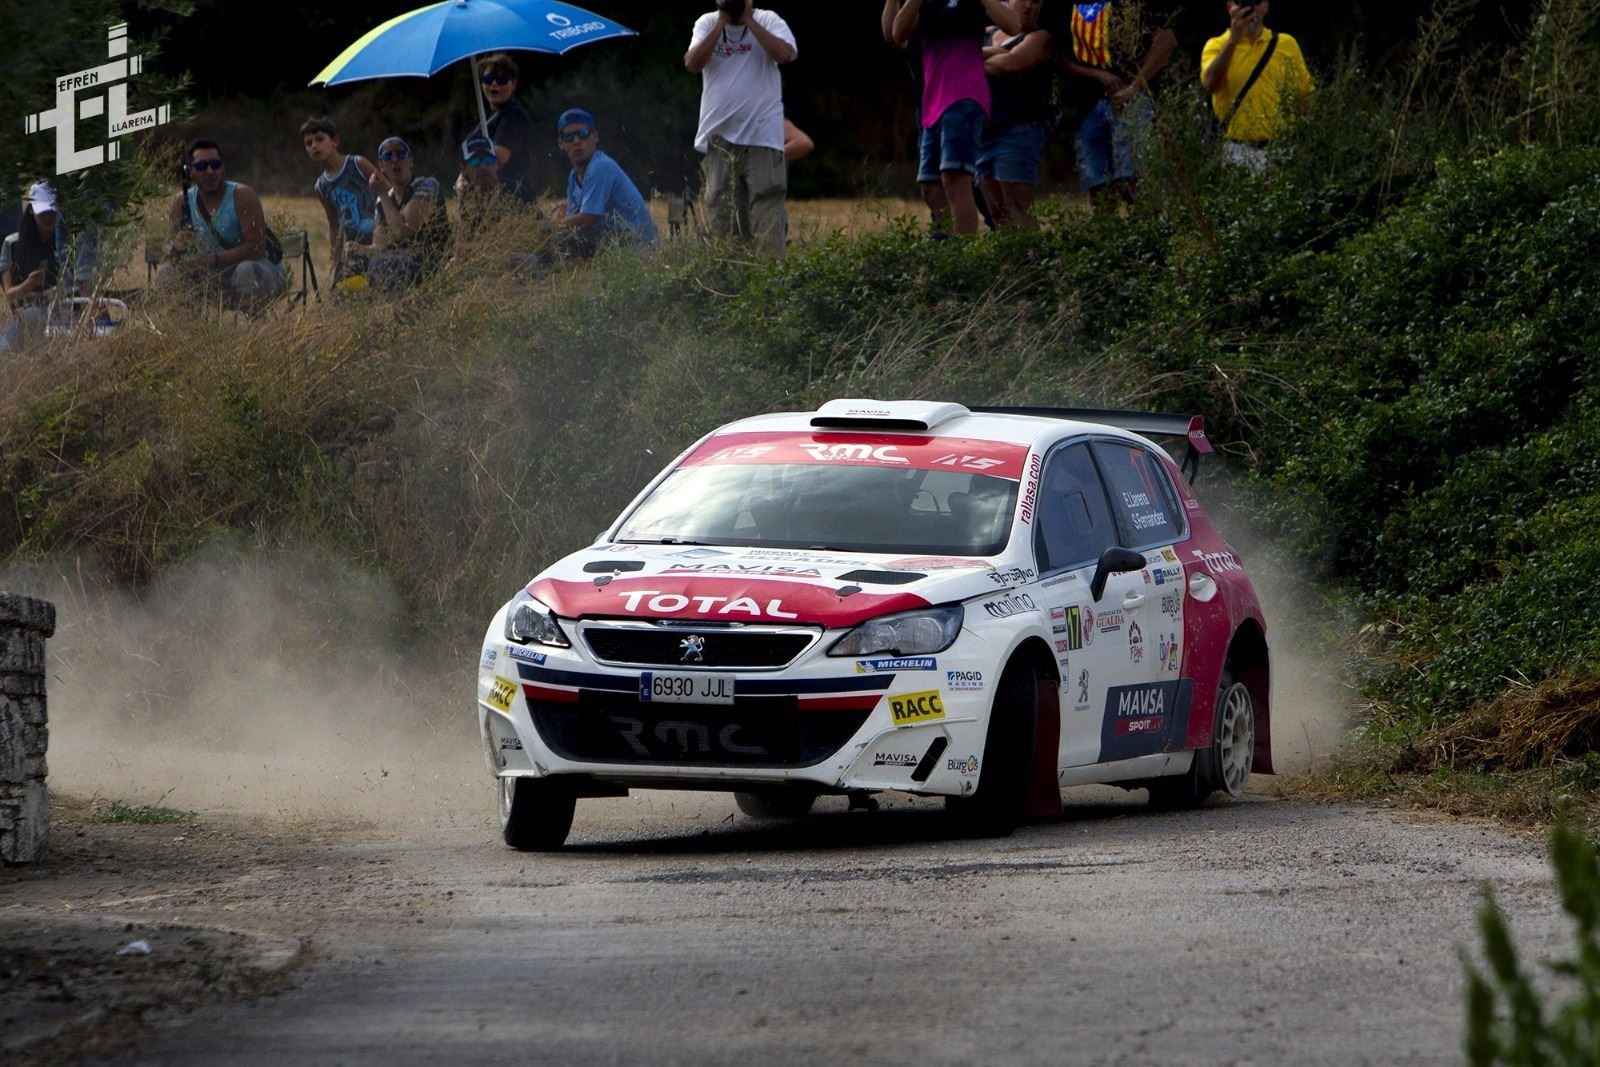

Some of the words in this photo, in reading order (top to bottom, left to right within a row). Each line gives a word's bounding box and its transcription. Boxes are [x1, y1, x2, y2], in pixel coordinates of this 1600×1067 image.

[549, 21, 606, 40] TRIBORD
[1020, 453, 1041, 525] rallasa.com
[669, 563, 823, 577] MAVISA
[1163, 568, 1180, 577] RALLY
[618, 590, 798, 620] TOTAL
[1096, 615, 1124, 628] GUALDA
[510, 647, 544, 663] MICHELIN
[877, 659, 933, 668] MICHELIN
[955, 671, 982, 681] PAGID
[653, 677, 693, 696] 6930
[701, 679, 731, 698] JJL
[891, 695, 942, 720] RACC
[875, 752, 918, 763] MAVISA
